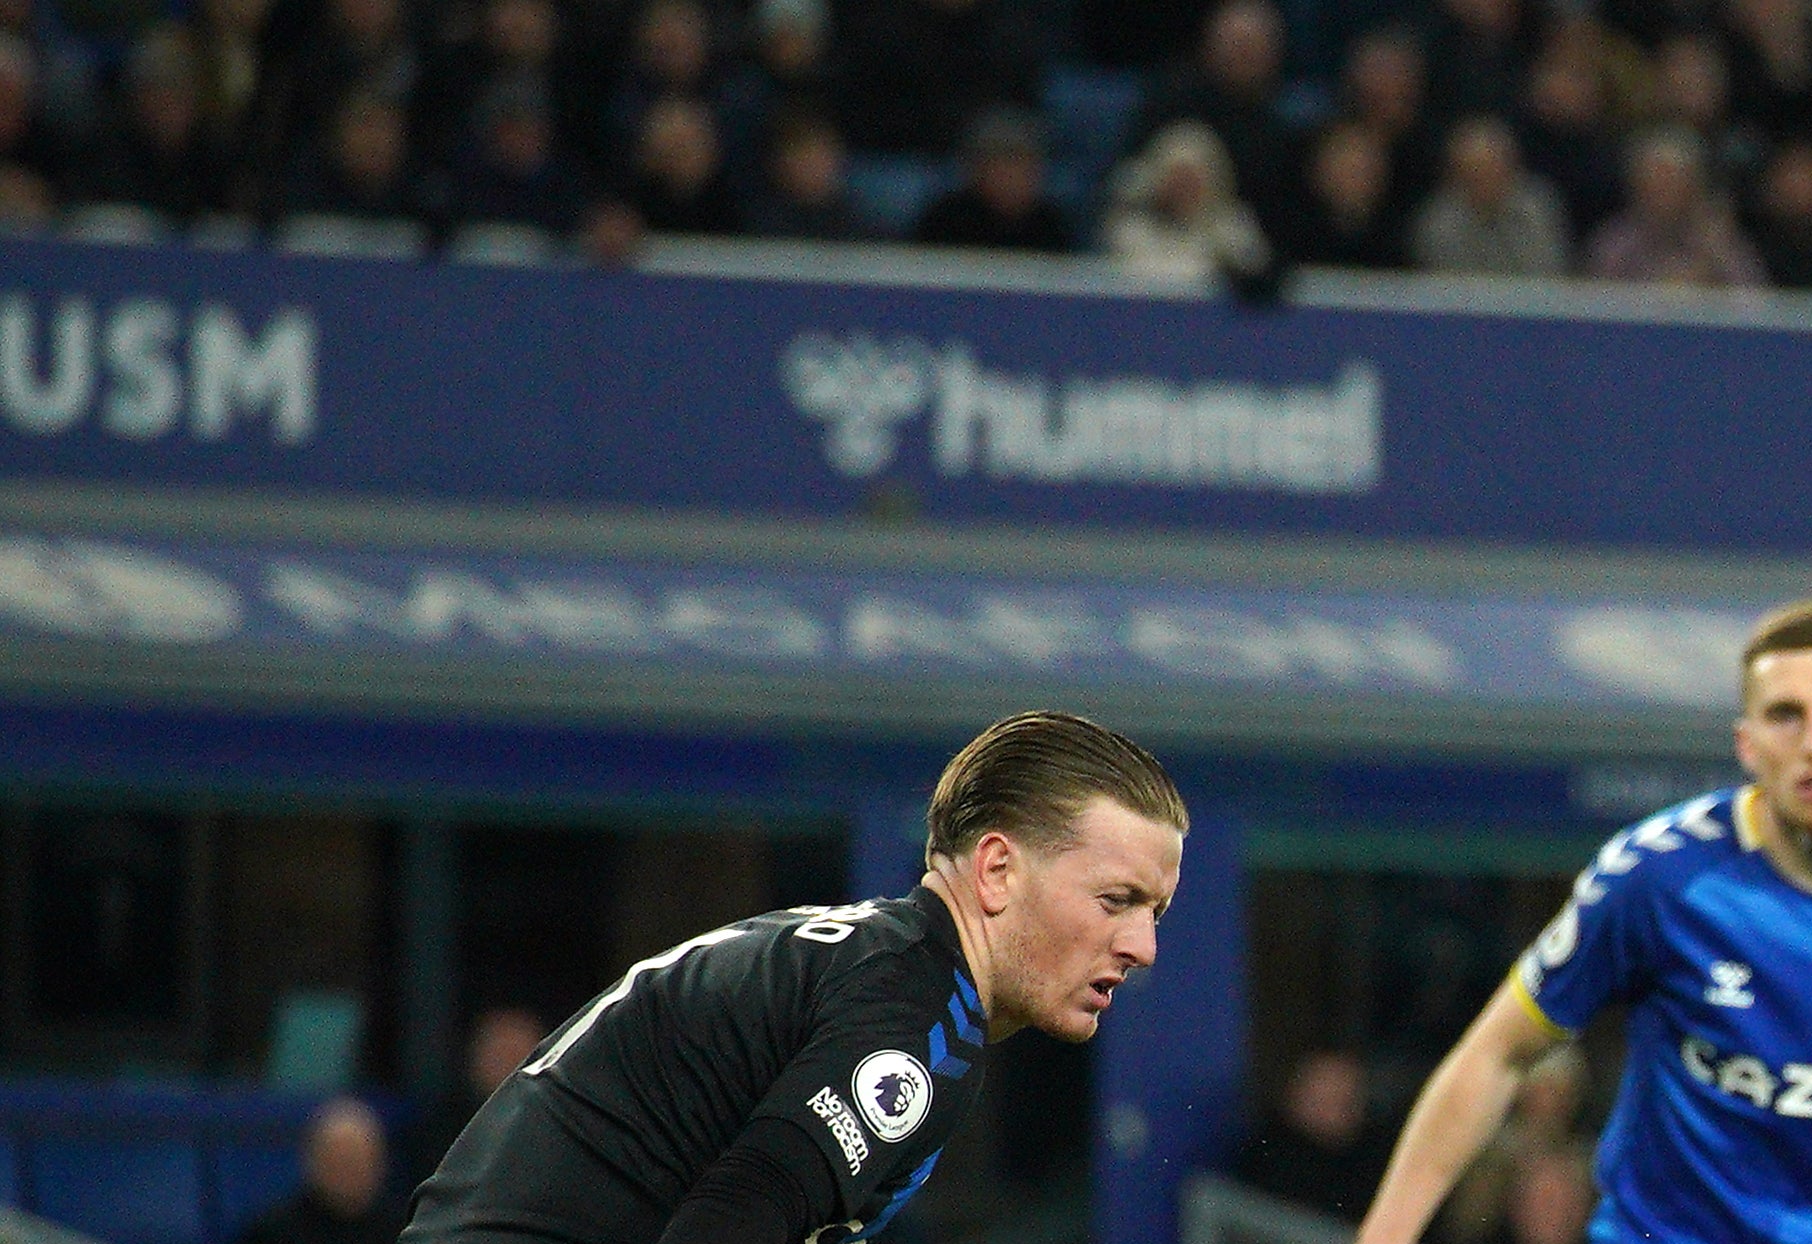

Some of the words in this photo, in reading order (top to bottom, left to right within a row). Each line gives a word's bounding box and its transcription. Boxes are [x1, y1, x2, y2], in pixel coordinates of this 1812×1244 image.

[0, 290, 319, 447] USM
[930, 340, 1386, 494] hummel
[826, 1117, 861, 1177] racism
[838, 1112, 869, 1161] room
